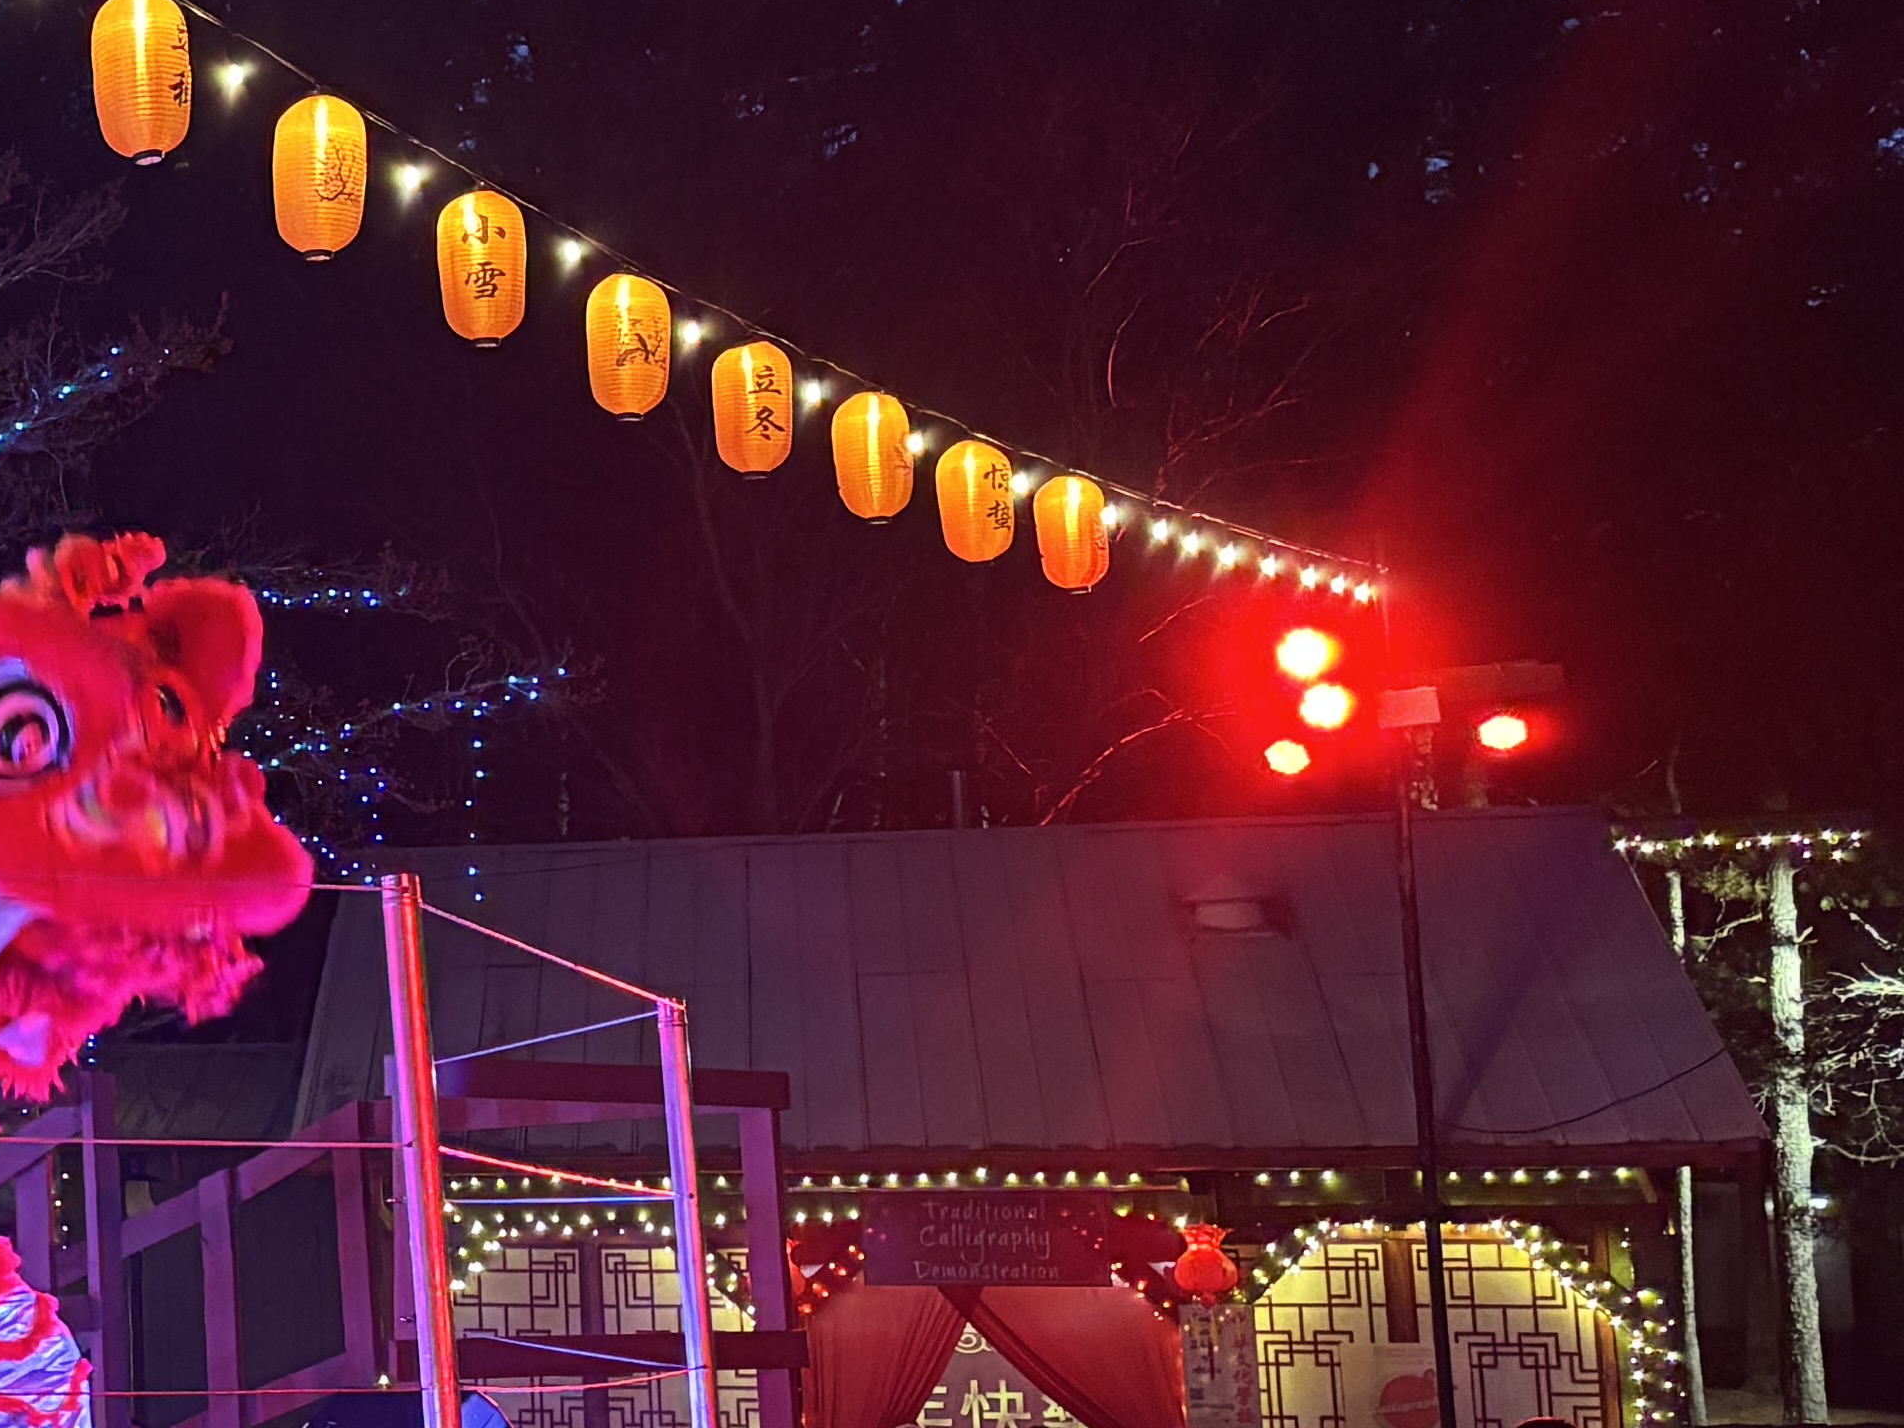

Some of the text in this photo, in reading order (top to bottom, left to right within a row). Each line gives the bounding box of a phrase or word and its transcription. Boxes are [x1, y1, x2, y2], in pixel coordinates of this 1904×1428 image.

[462, 214, 506, 300] 小雪
[745, 365, 787, 441] 立冬
[921, 1198, 1046, 1221] Traditional
[919, 1224, 1051, 1266] Calligraphy
[914, 1260, 1061, 1280] Demonstration
